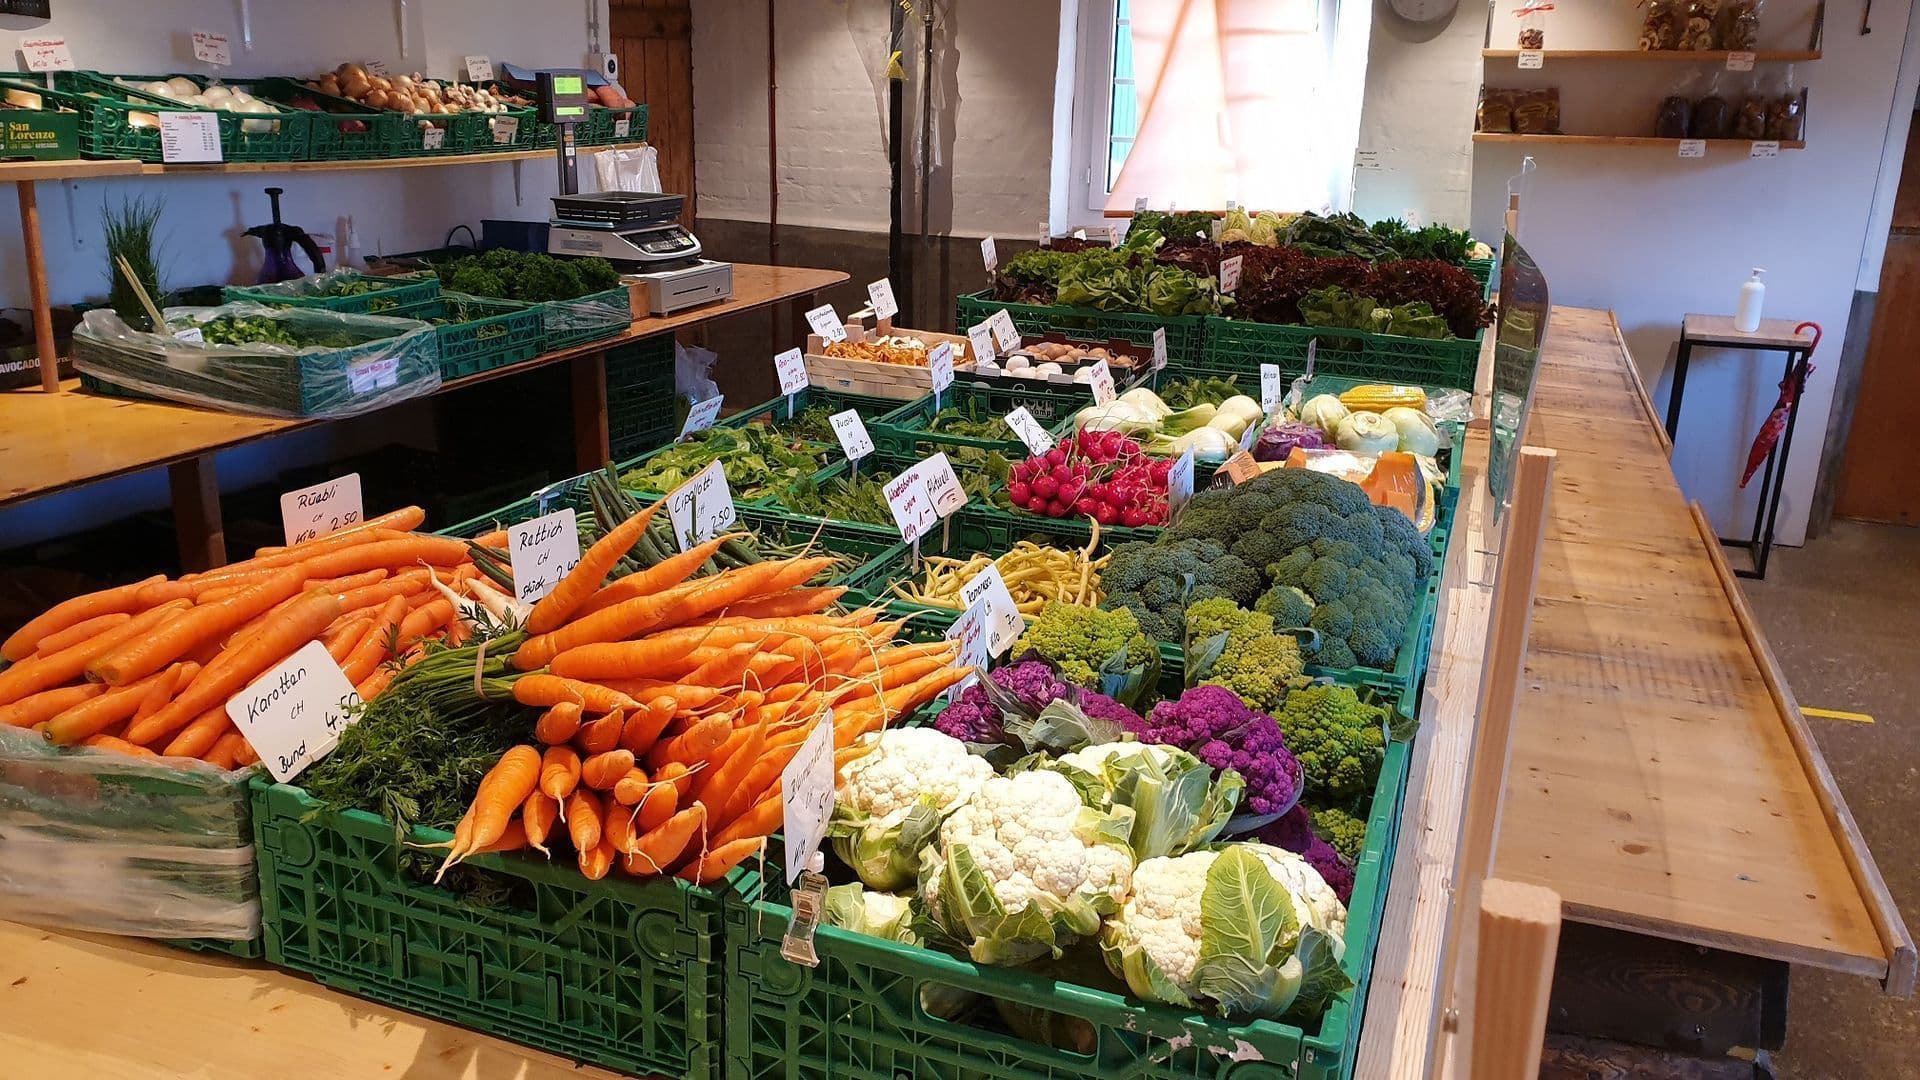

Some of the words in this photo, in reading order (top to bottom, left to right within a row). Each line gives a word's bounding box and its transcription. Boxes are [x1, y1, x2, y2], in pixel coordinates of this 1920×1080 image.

[9, 121, 29, 131] San
[10, 131, 56, 140] Lorenzo
[312, 512, 325, 523] CH
[330, 510, 358, 532] 2.50
[519, 519, 562, 551] Rettich
[537, 548, 551, 566] CH
[521, 575, 546, 600] Stück
[248, 667, 307, 724] Karotten
[290, 699, 304, 720] CH
[278, 739, 307, 774] Bund
